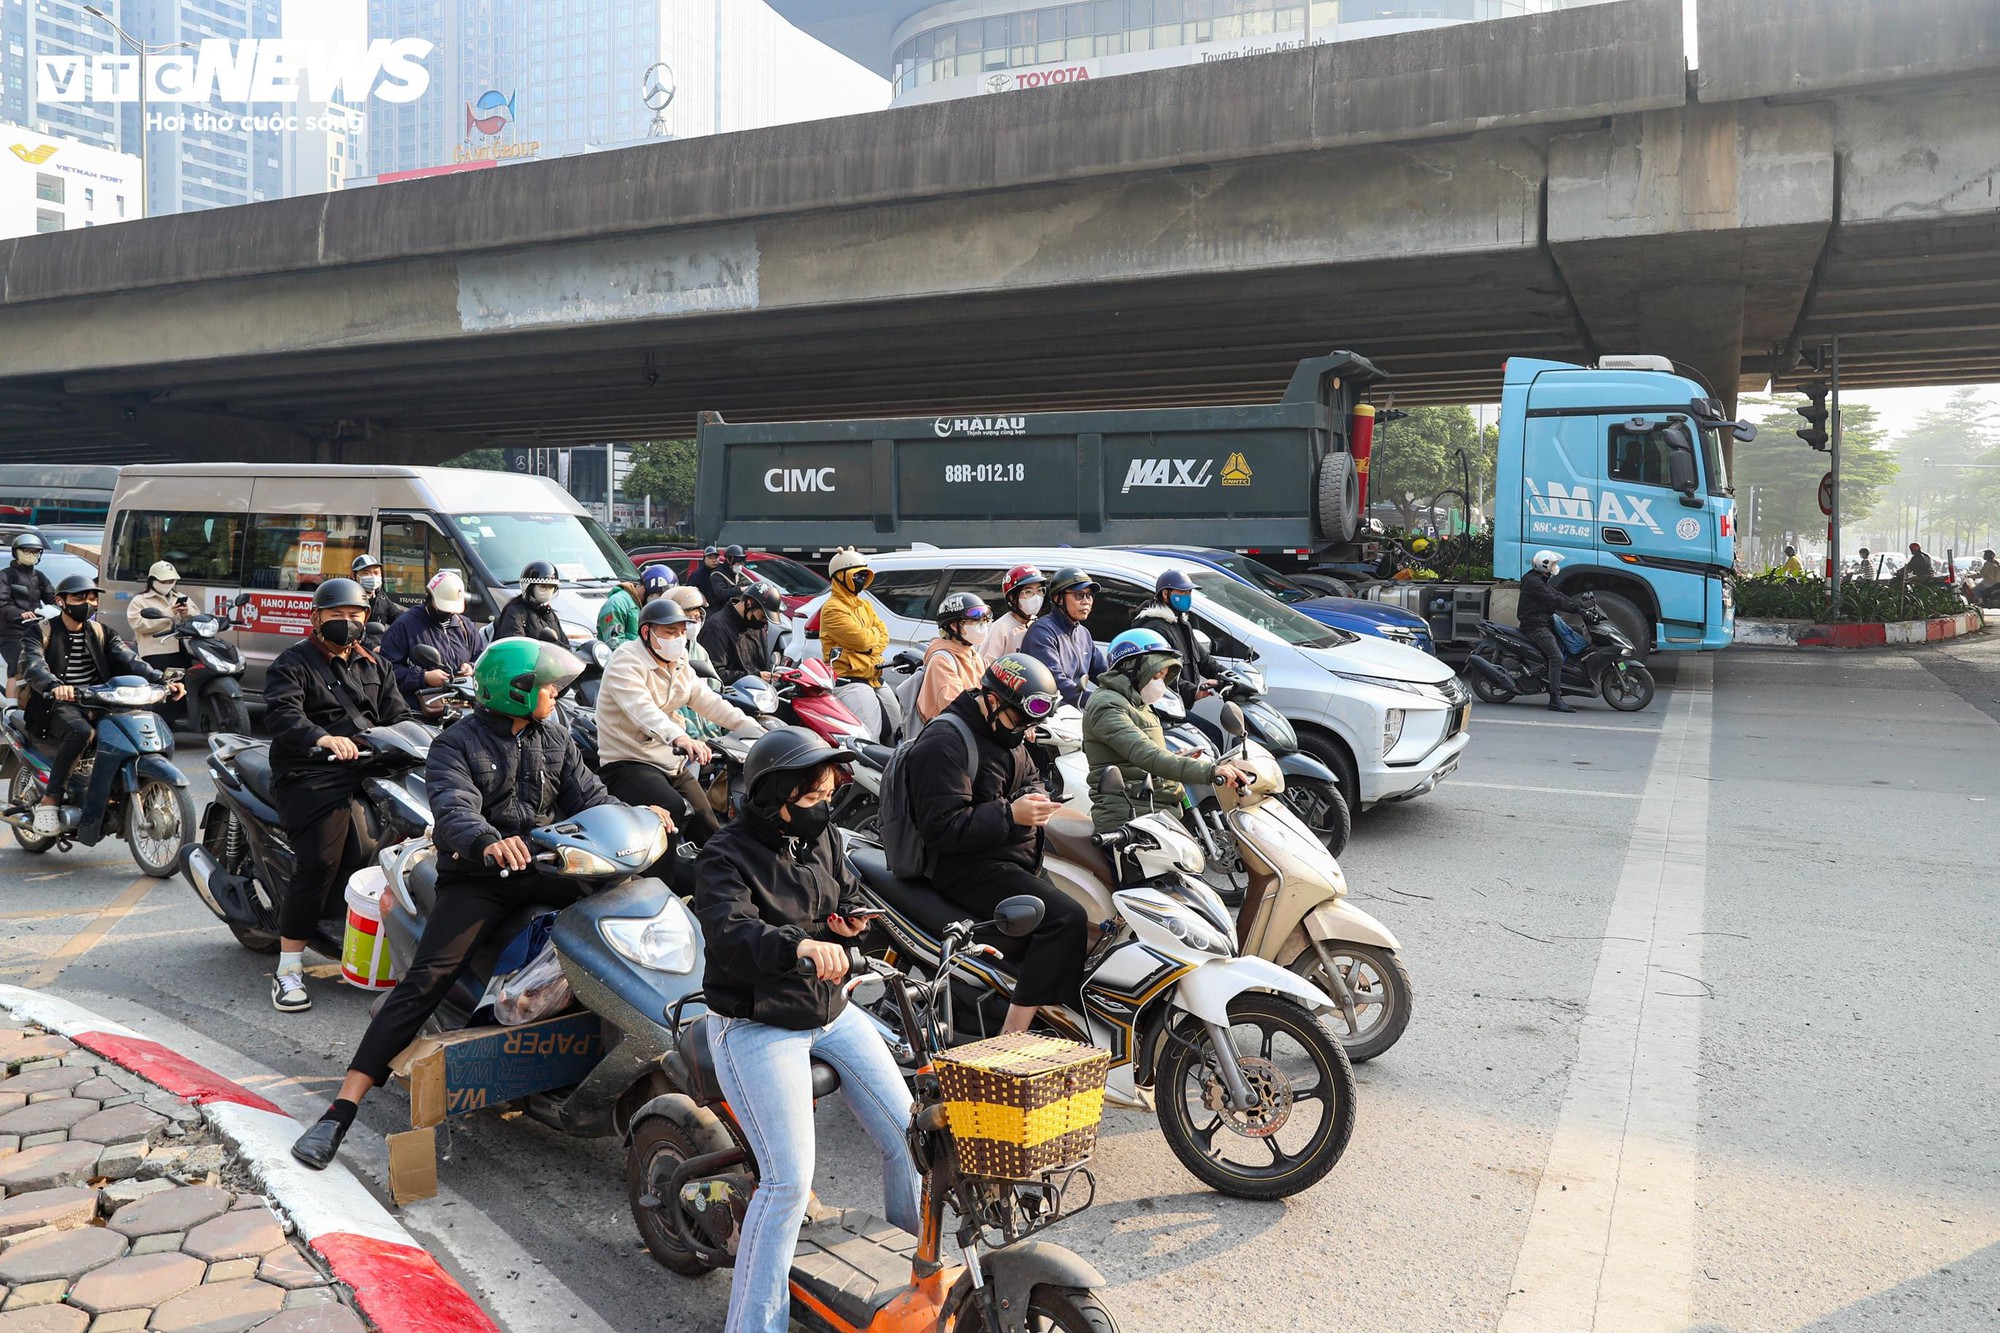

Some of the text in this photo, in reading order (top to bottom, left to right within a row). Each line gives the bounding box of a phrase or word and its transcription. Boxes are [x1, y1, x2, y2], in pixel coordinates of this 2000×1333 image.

[1016, 66, 1089, 89] TOYOTA
[454, 140, 540, 163] GAMI GROUP
[56, 164, 124, 184] VIETNAM POST
[764, 466, 836, 493] CIMC
[945, 463, 1025, 483] 88R-012.18
[261, 598, 286, 609] HANOI
[503, 1030, 591, 1055] PAPER
